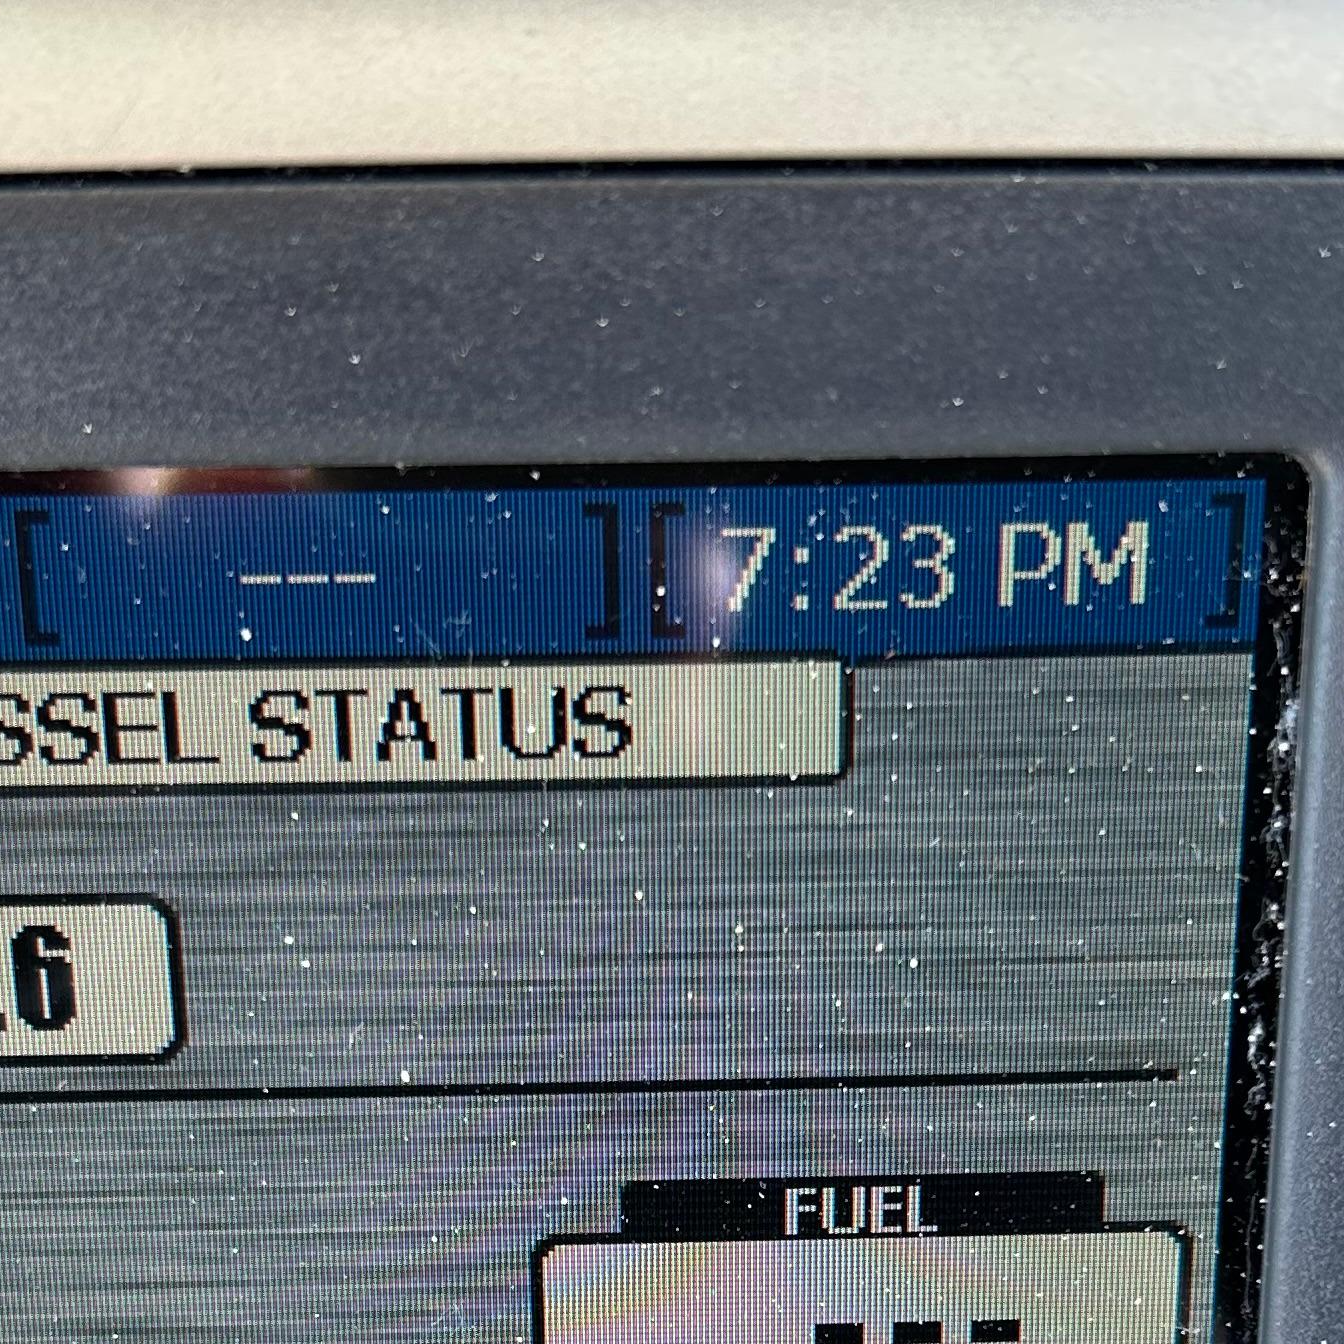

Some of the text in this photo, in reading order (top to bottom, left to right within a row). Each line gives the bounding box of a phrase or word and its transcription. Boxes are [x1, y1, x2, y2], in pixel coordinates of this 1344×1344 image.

[720, 520, 1150, 612] 7:23 PM
[248, 684, 632, 764] STATUS
[784, 1184, 939, 1236] FUEL
